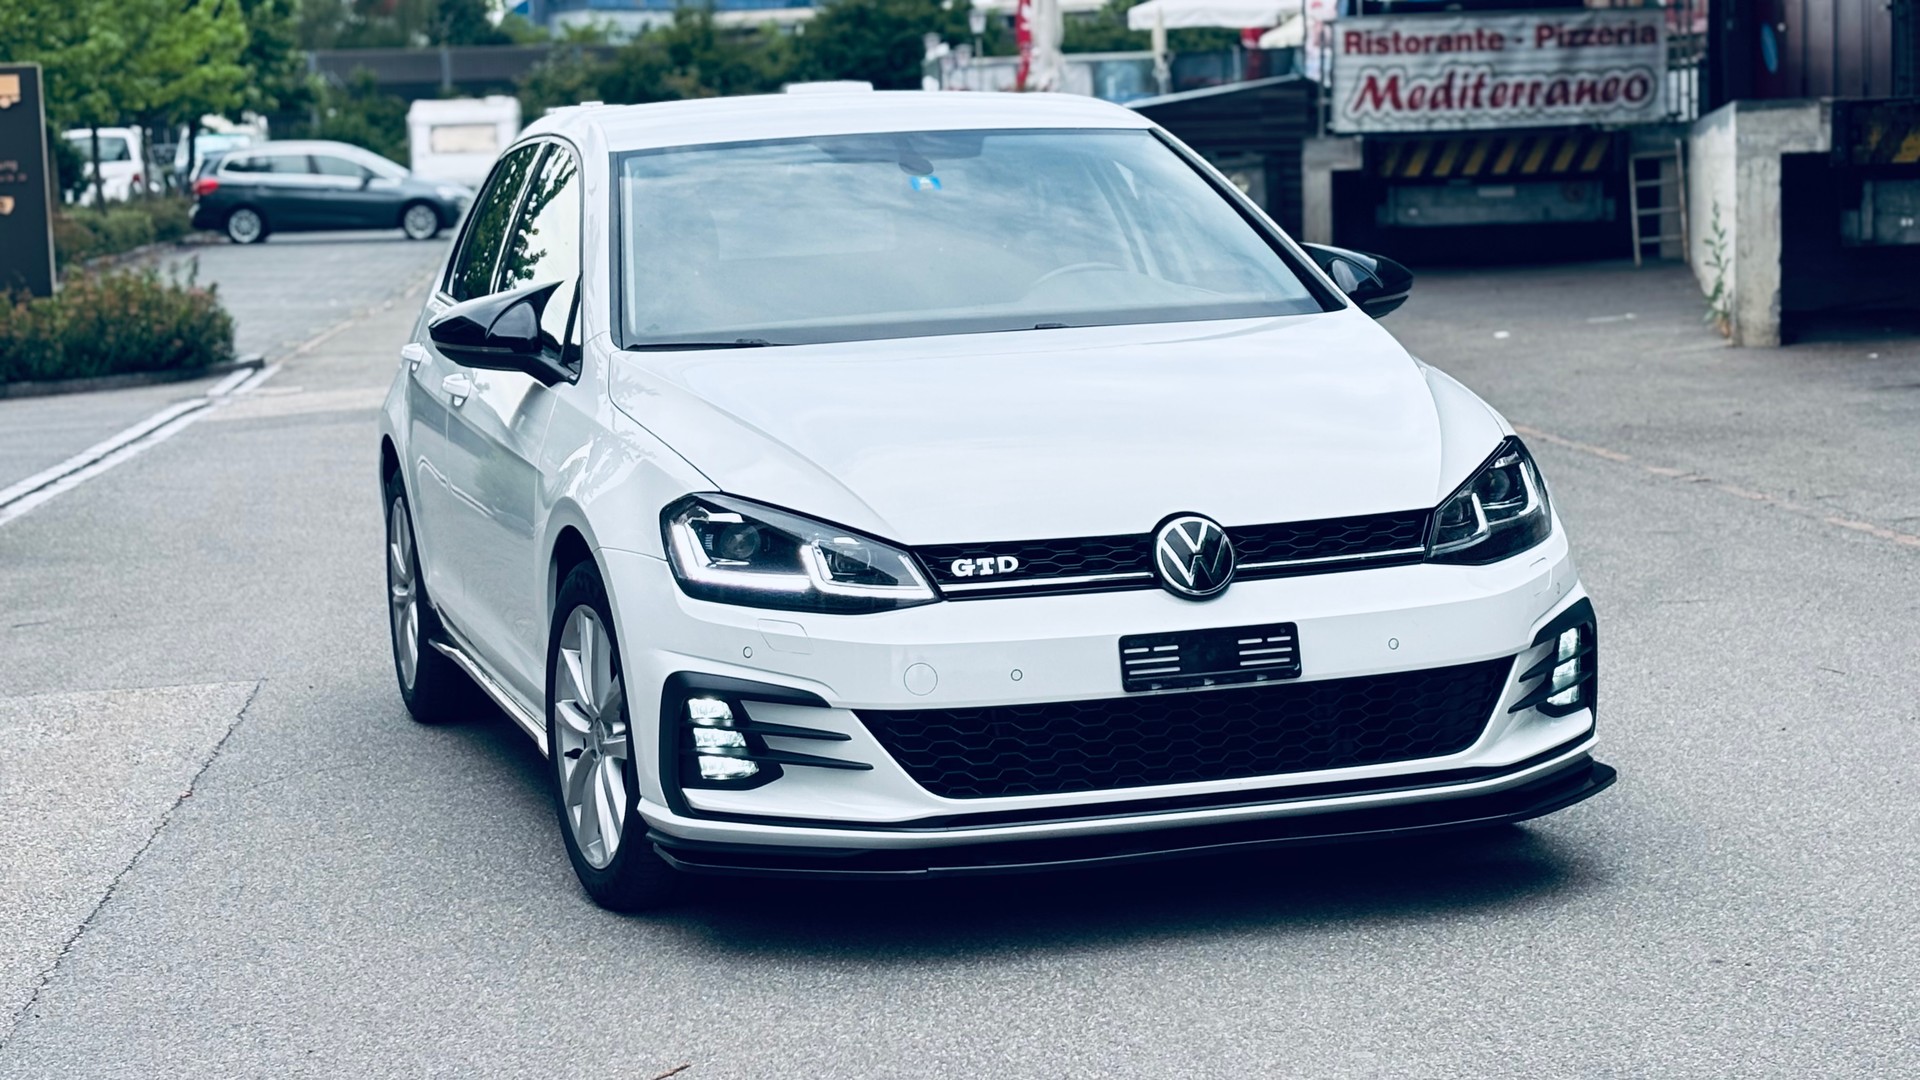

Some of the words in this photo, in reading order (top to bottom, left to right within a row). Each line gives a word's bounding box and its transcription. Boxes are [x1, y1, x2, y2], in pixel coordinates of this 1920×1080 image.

[1344, 27, 1505, 55] Ristorante
[1535, 21, 1657, 48] Pizzeria
[1353, 70, 1649, 111] Mediterraneo
[950, 555, 1019, 577] GTD
